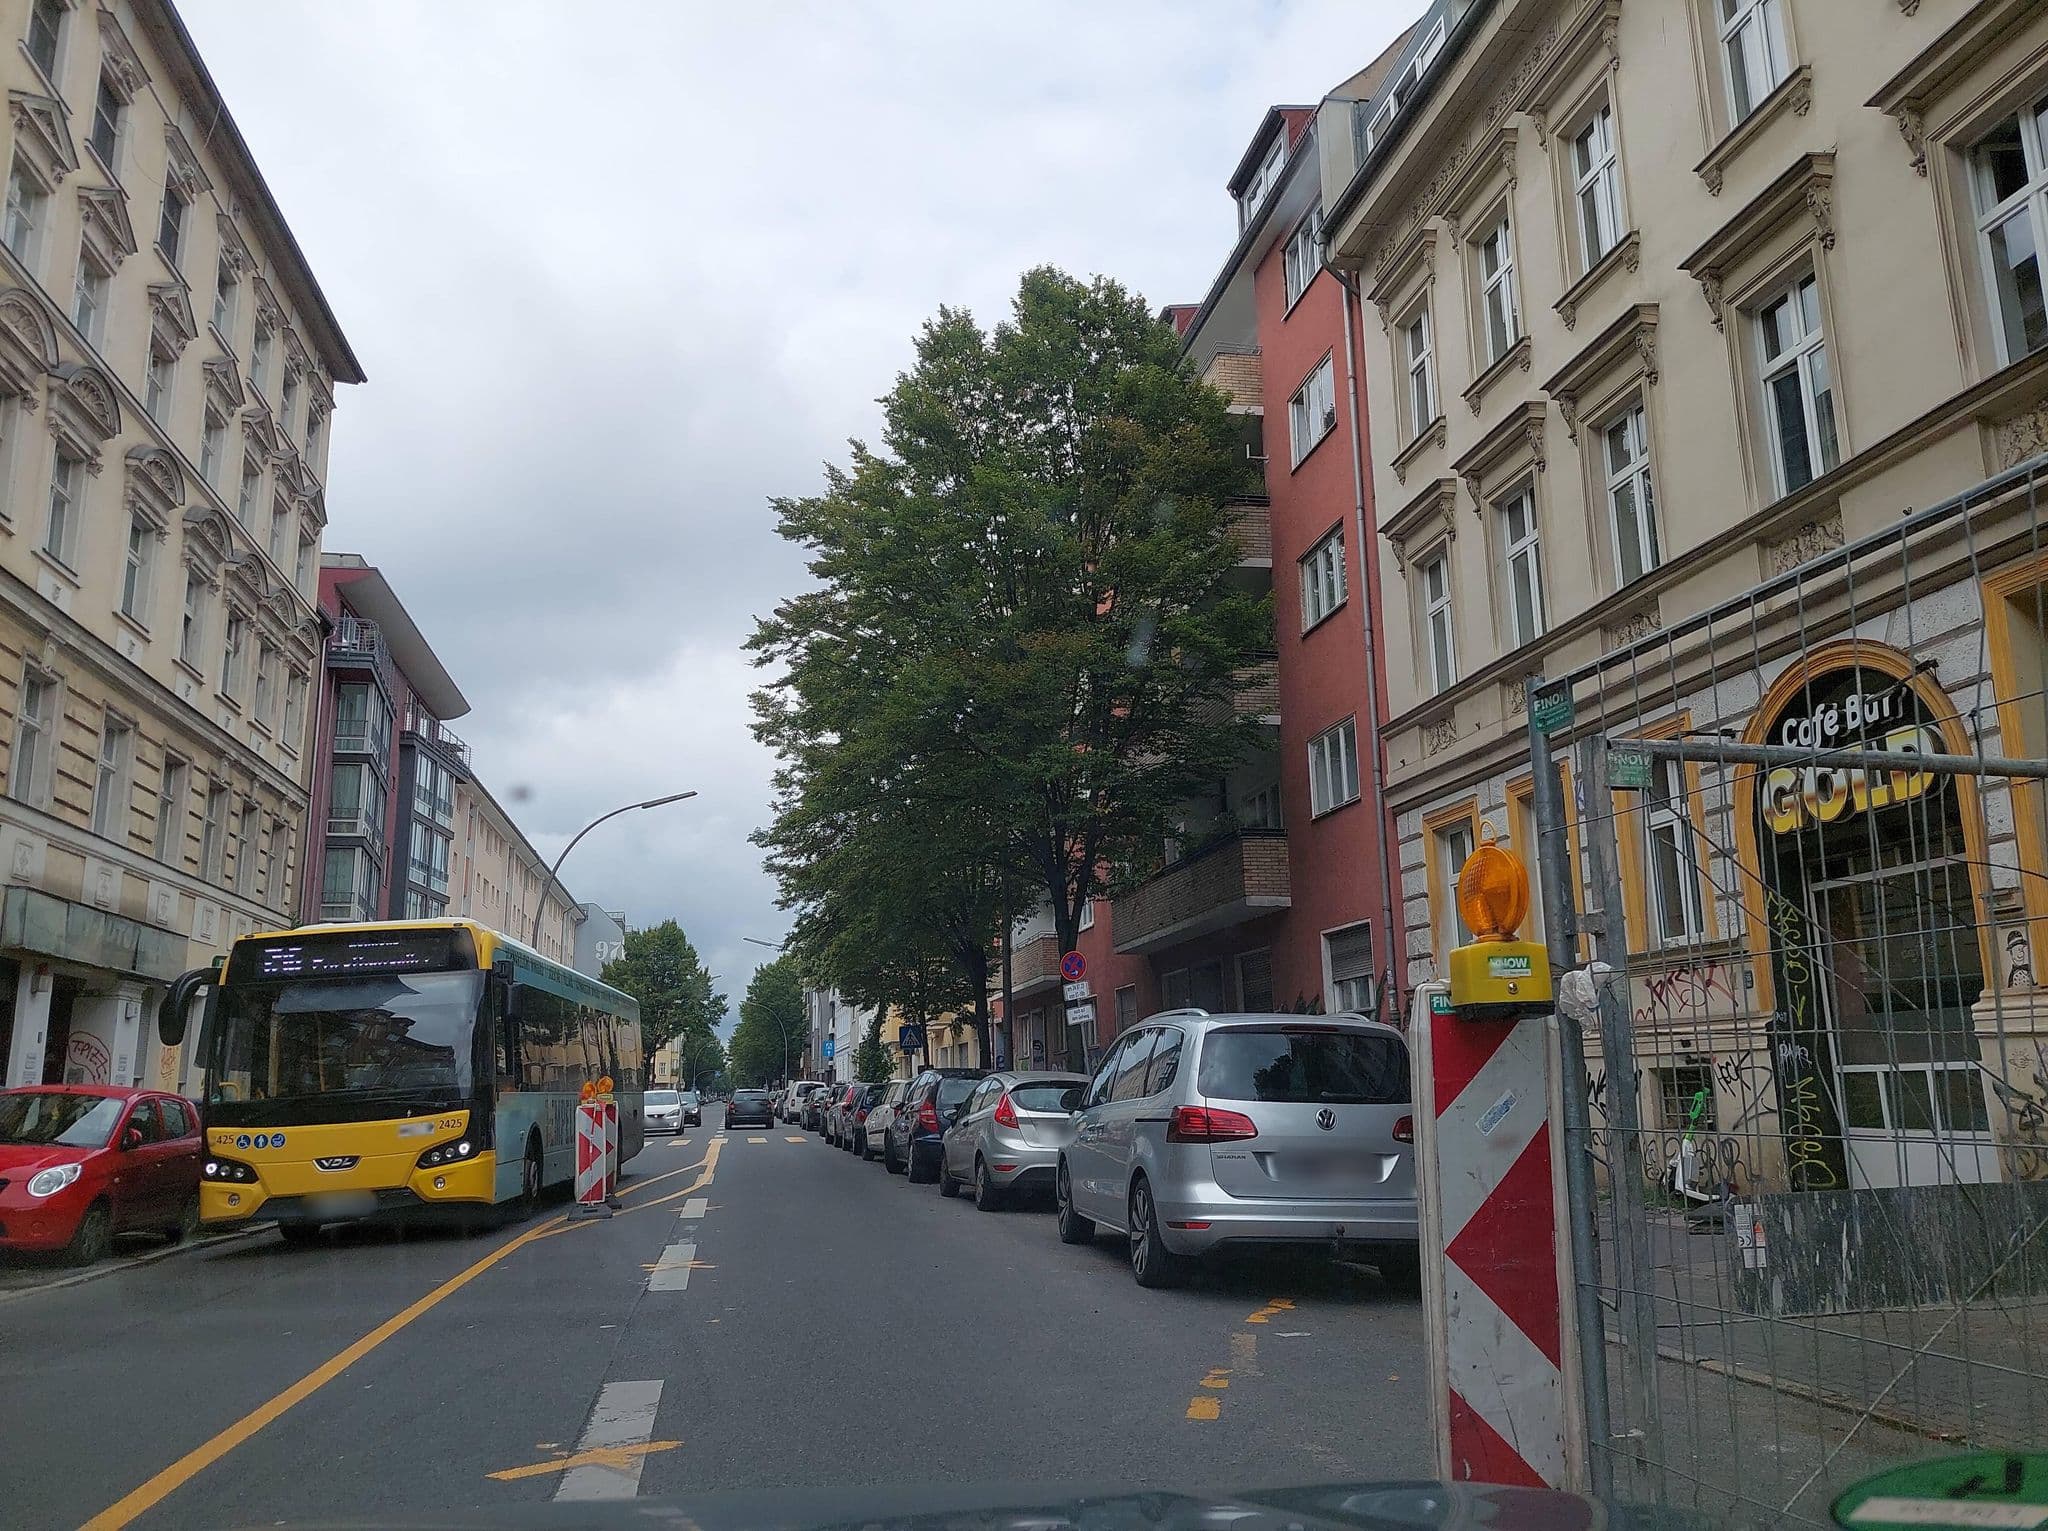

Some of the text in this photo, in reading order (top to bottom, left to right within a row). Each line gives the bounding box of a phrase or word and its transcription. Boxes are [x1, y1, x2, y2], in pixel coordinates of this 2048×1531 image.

[1762, 724, 1940, 835] GOLD
[439, 1119, 462, 1129] 2425
[320, 1157, 353, 1168] VDL
